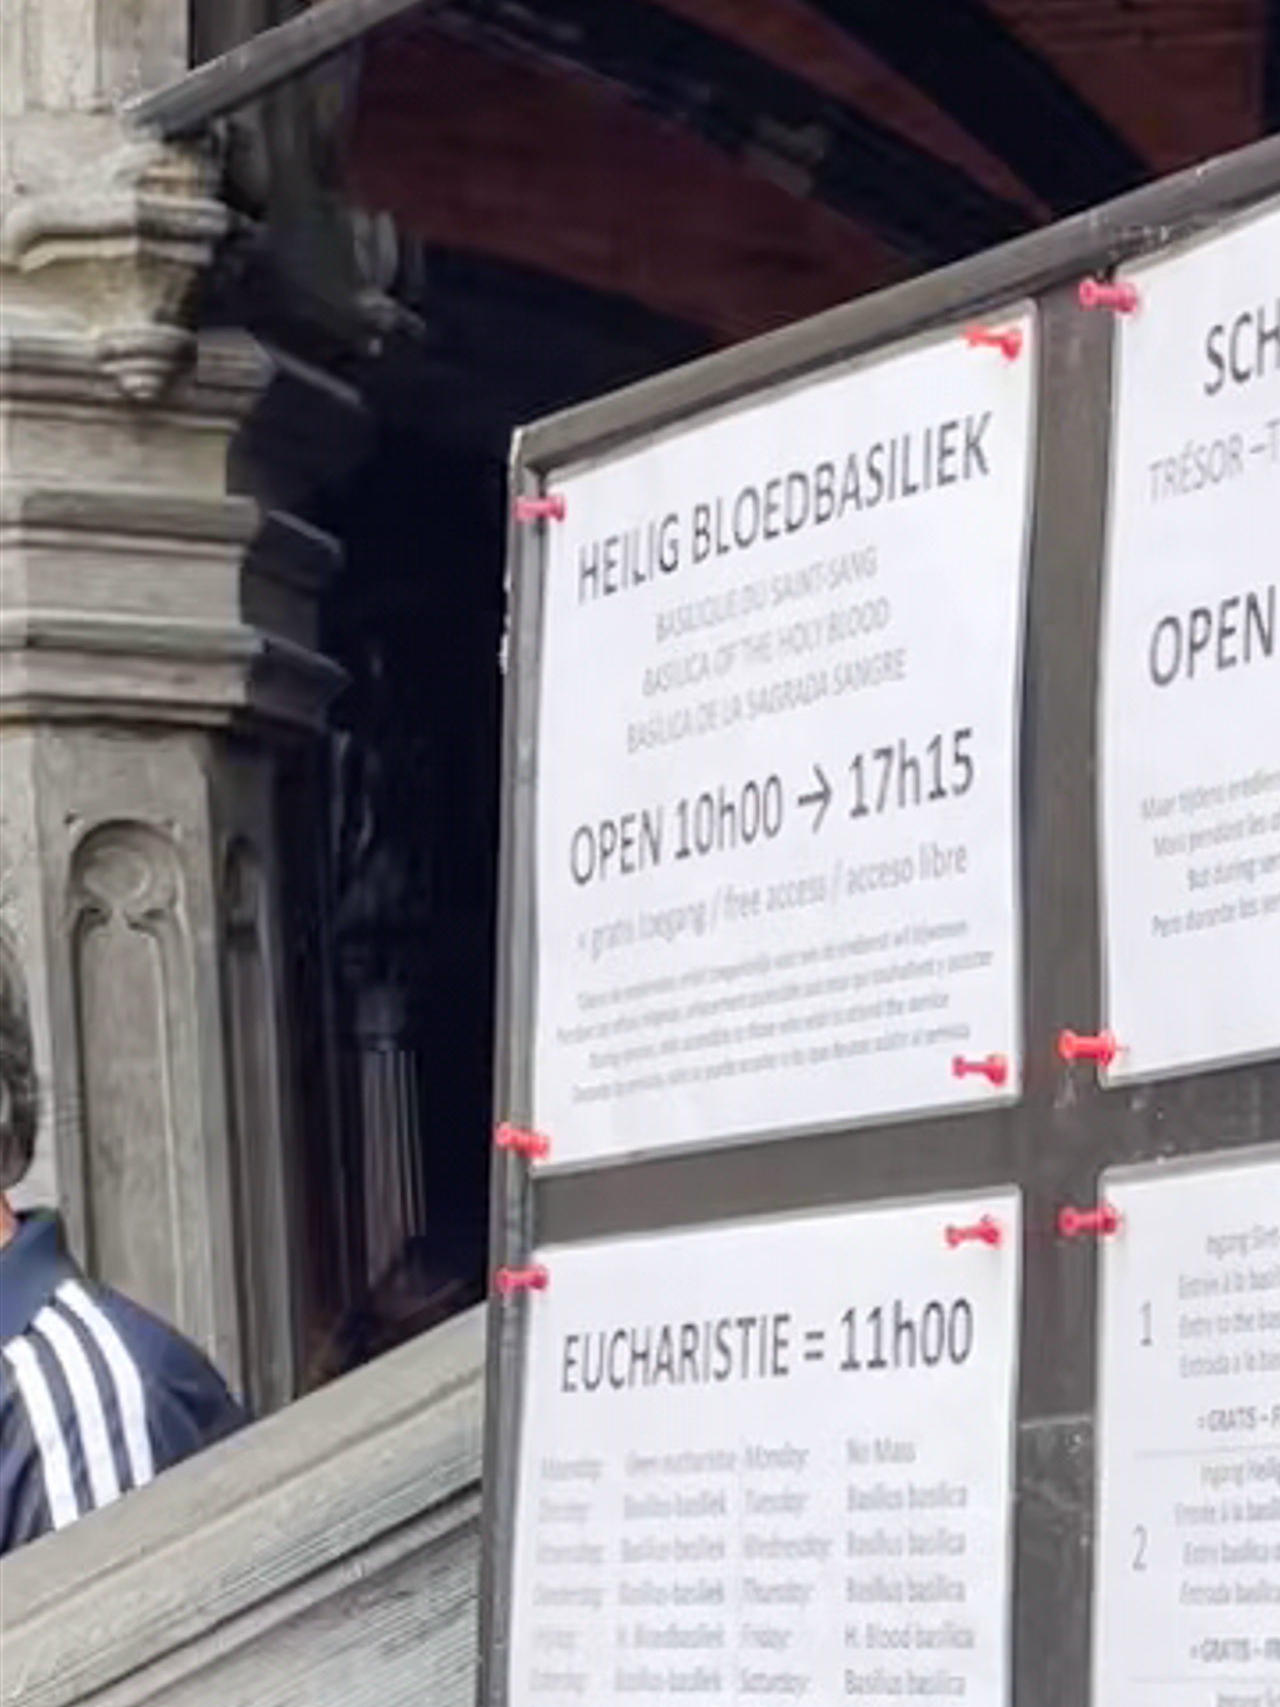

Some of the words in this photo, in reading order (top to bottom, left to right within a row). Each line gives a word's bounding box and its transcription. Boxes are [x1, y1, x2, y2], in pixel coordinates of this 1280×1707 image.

[1149, 433, 1243, 499] TRÉSOR
[578, 513, 679, 599] HEILIG
[692, 415, 988, 561] BLOEDBASILIEK
[739, 629, 773, 663] THE
[779, 619, 822, 655] HOLY
[826, 596, 890, 644] BLOOD
[1149, 587, 1275, 685] OPEN
[746, 670, 828, 720] SAGRADA
[833, 647, 905, 695] SANGRE
[570, 810, 661, 885] OPEN
[675, 774, 782, 859] 10h00
[849, 728, 973, 817] 17h15
[723, 884, 761, 919] free
[765, 875, 826, 912] access
[846, 855, 914, 895] acceso
[918, 841, 967, 879] libre
[562, 1314, 789, 1391] EUCHARISTIE
[840, 1298, 973, 1371] 11h00
[1206, 1405, 1257, 1432] GRATIS
